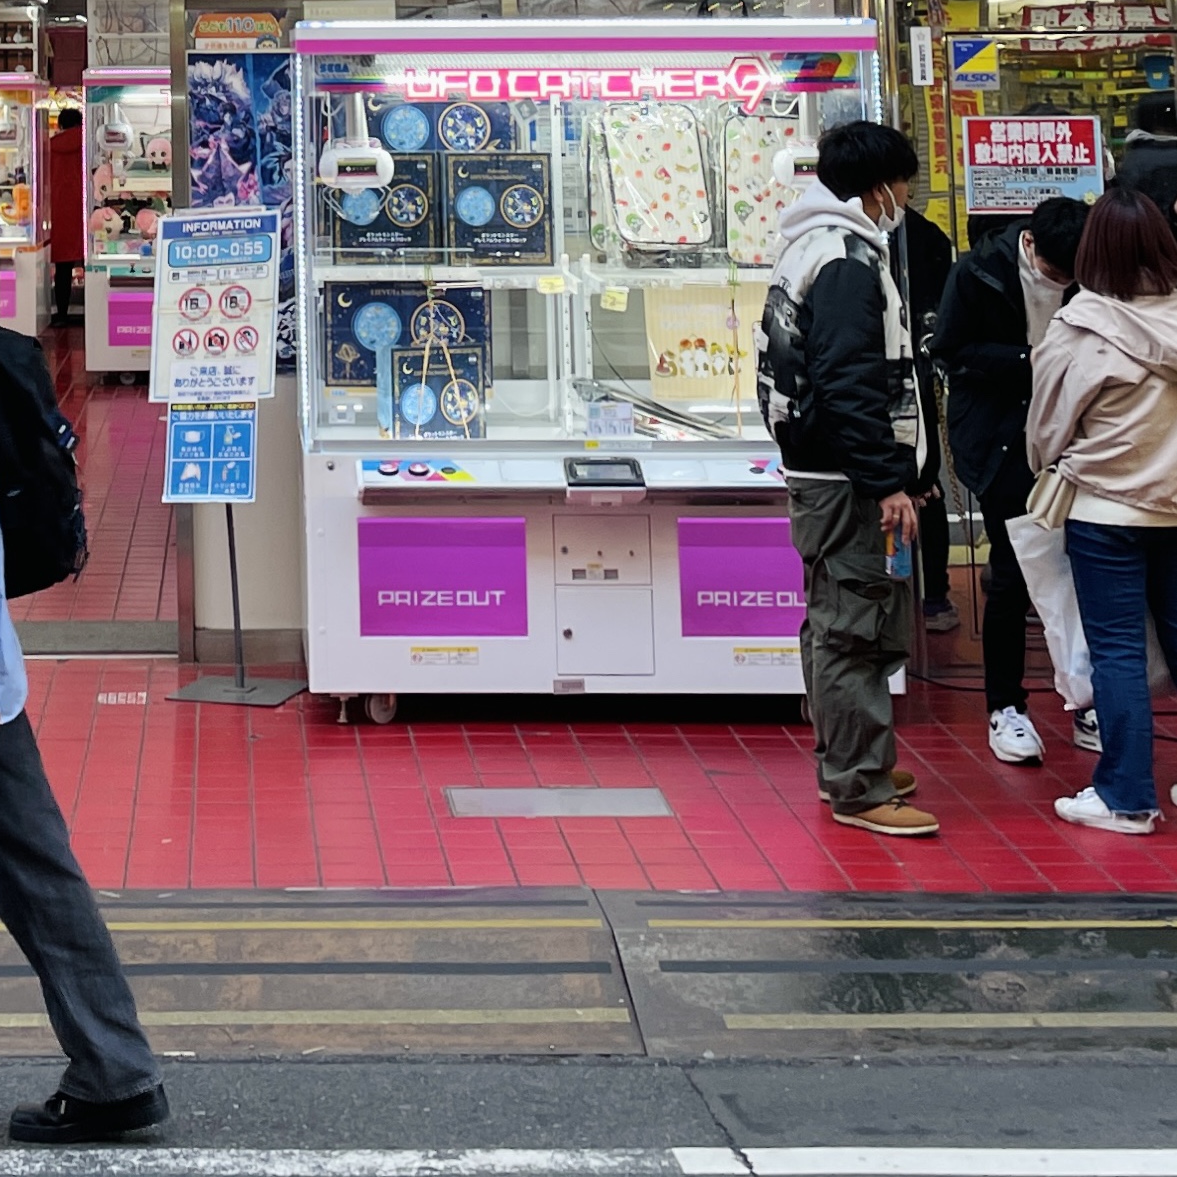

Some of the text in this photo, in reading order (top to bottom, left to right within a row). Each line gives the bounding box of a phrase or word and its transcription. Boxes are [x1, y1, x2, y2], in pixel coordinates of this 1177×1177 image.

[319, 64, 350, 73] SEGA
[405, 66, 503, 100] UFO
[507, 66, 732, 100] CATCHER
[955, 73, 997, 82] ALSOK
[990, 121, 1073, 143] 営業時間外
[974, 142, 1091, 165] 敷地内侵入禁止
[182, 218, 262, 233] INFORMATION
[378, 590, 506, 607] PRIZEOUT
